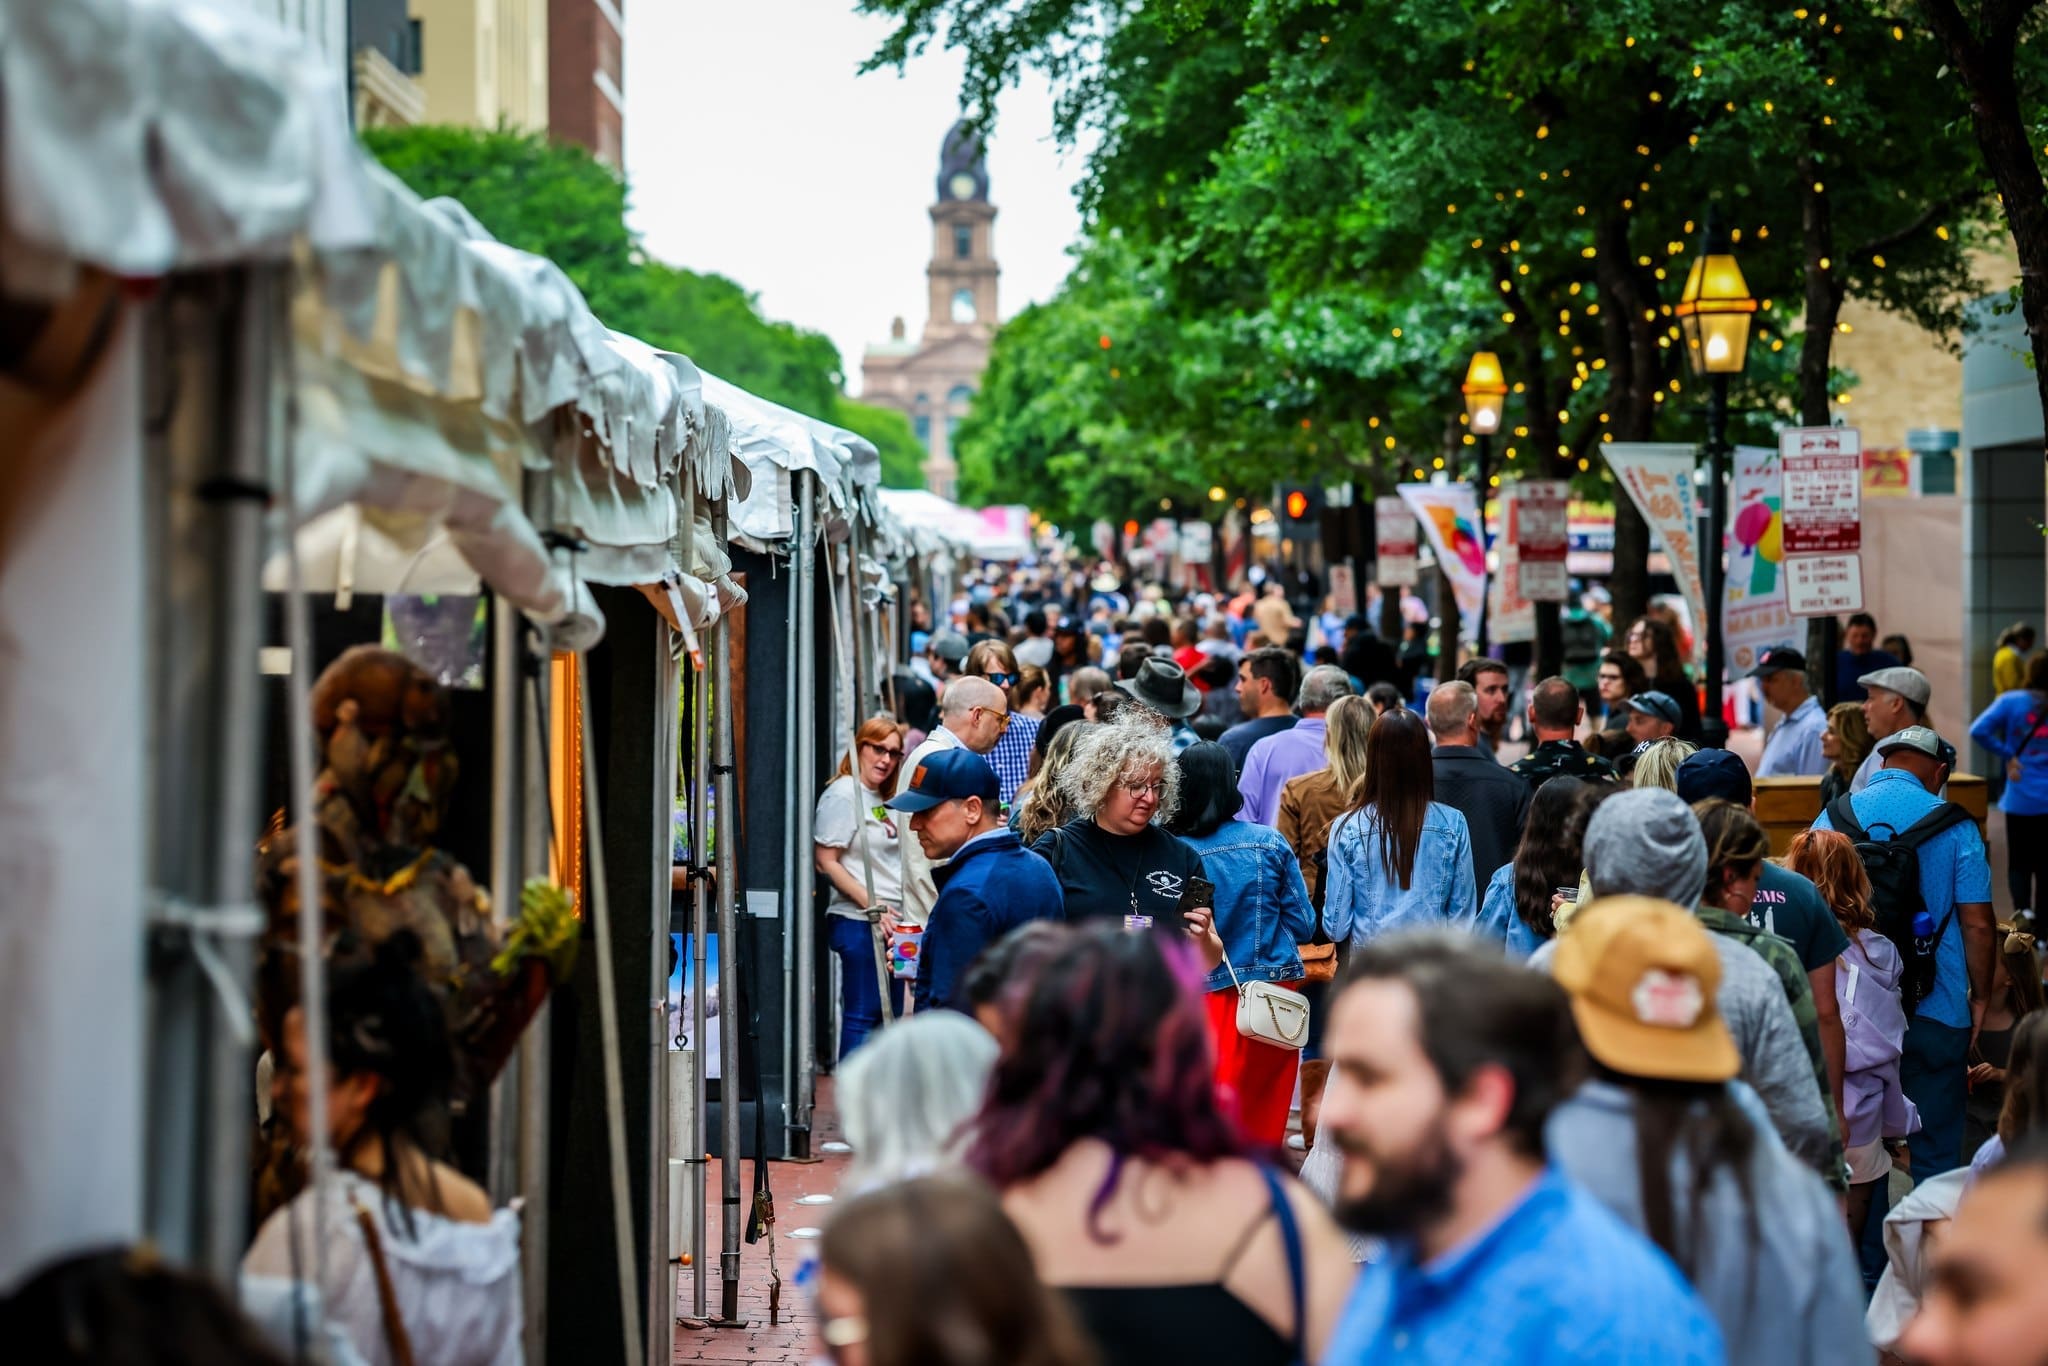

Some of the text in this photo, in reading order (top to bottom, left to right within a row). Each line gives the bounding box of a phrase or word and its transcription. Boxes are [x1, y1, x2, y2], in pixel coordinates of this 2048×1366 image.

[1797, 561, 1808, 571] NO
[1813, 572, 1849, 583] STANDING
[1818, 586, 1831, 595] ALL
[1801, 596, 1851, 608] OTHER TIMES
[1727, 609, 1772, 634] MAIN
